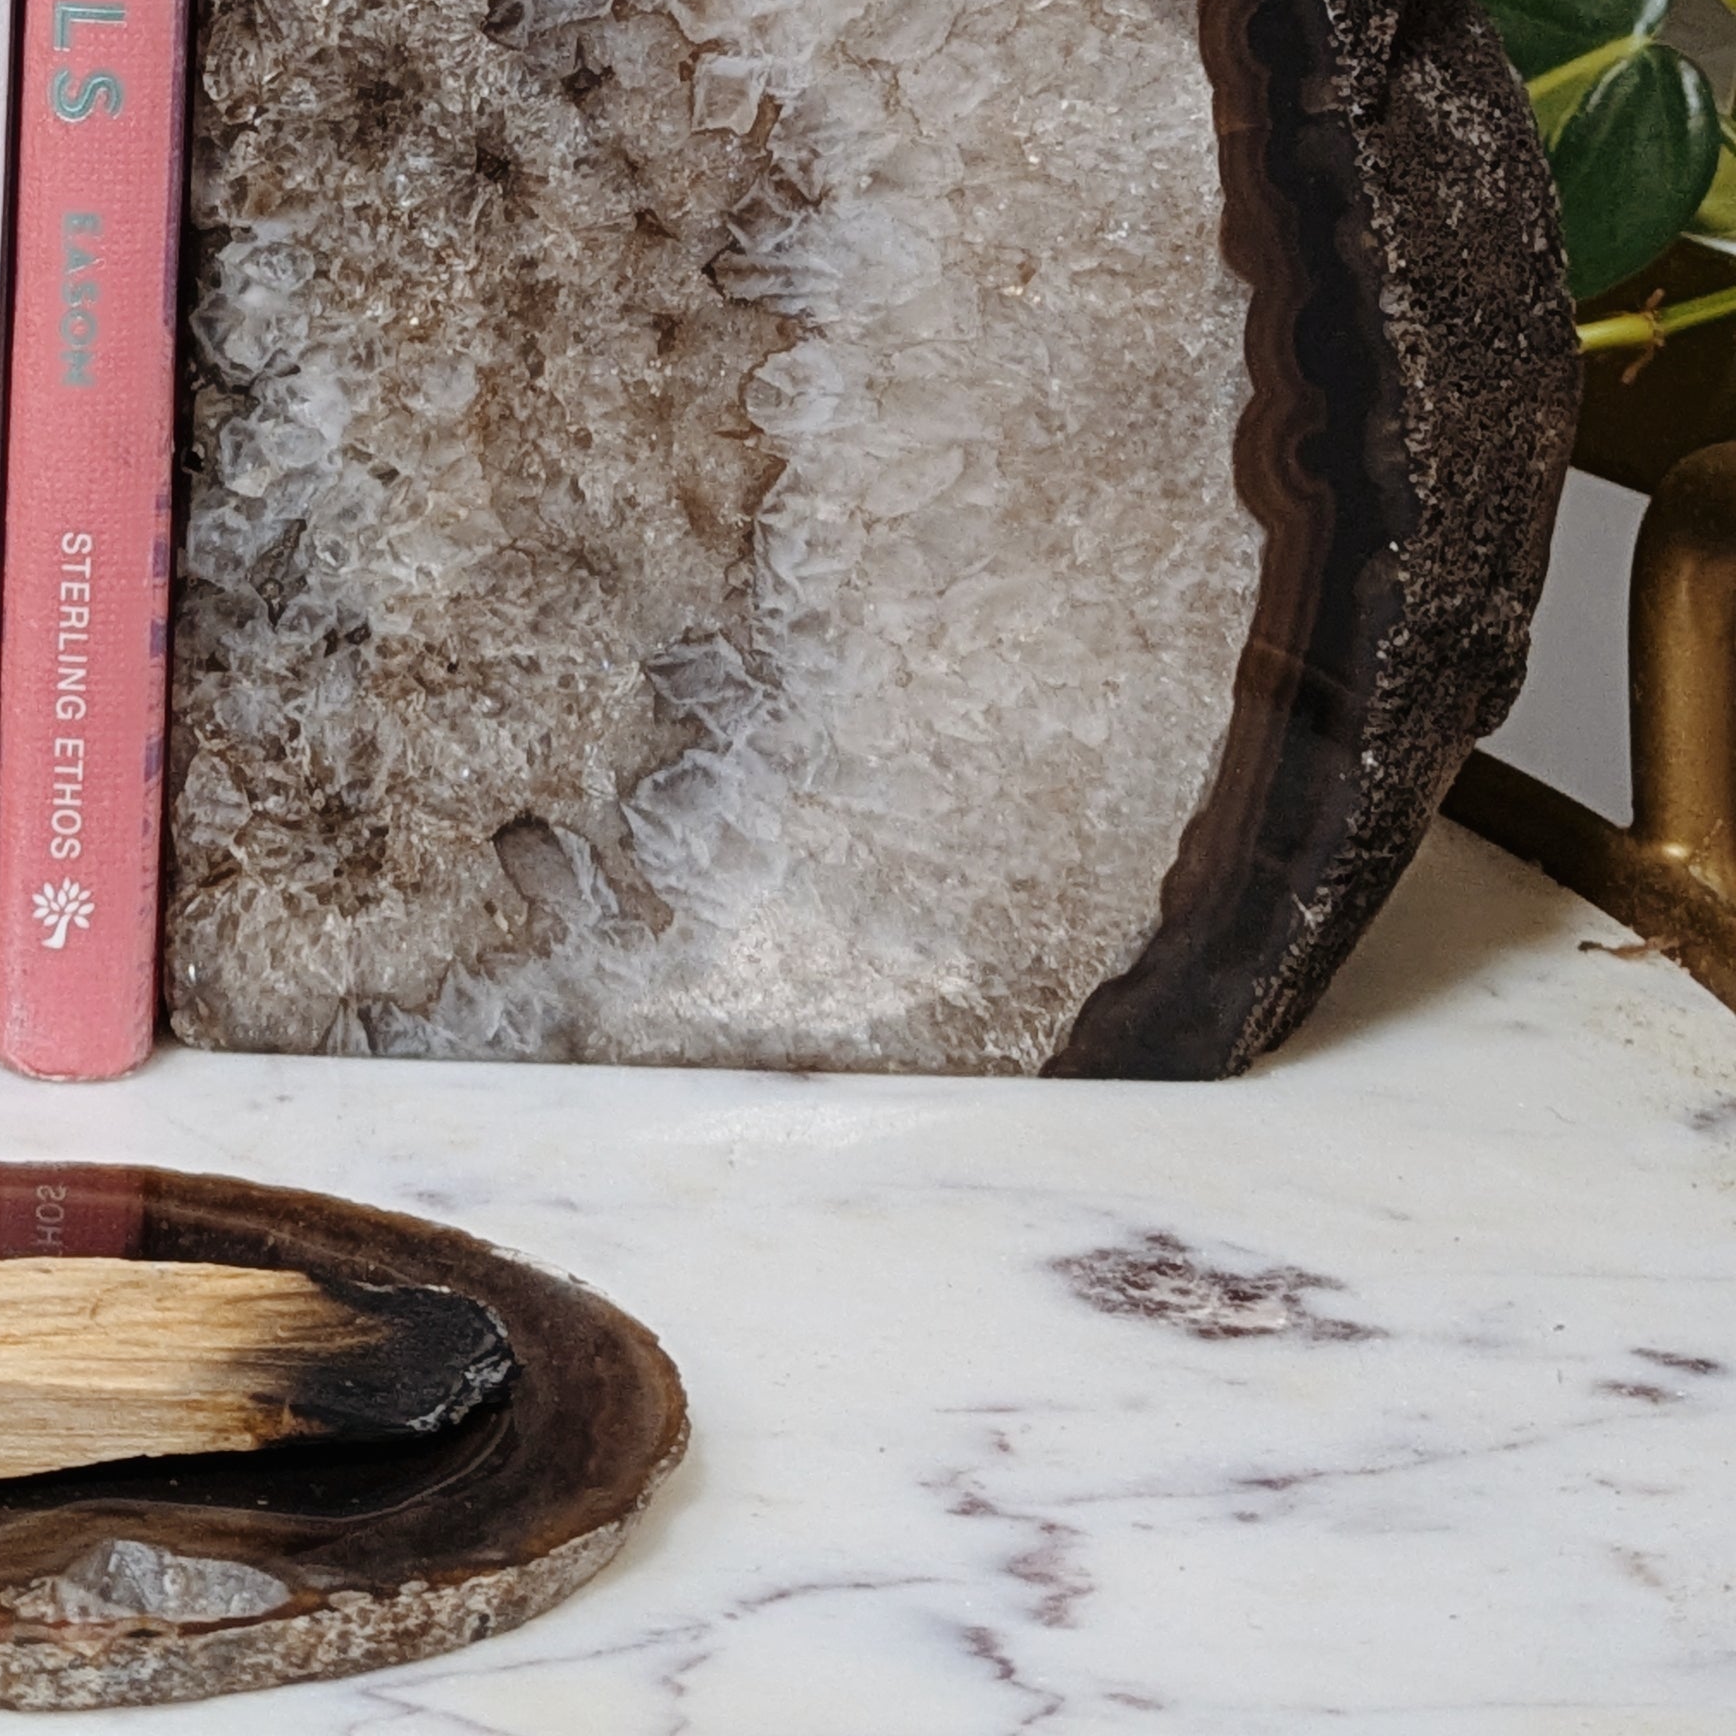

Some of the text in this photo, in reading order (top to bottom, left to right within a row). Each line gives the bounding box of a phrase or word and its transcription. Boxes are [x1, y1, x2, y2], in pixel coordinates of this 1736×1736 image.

[60, 212, 102, 387] EASON
[50, 532, 92, 859] STERLING ETHOS
